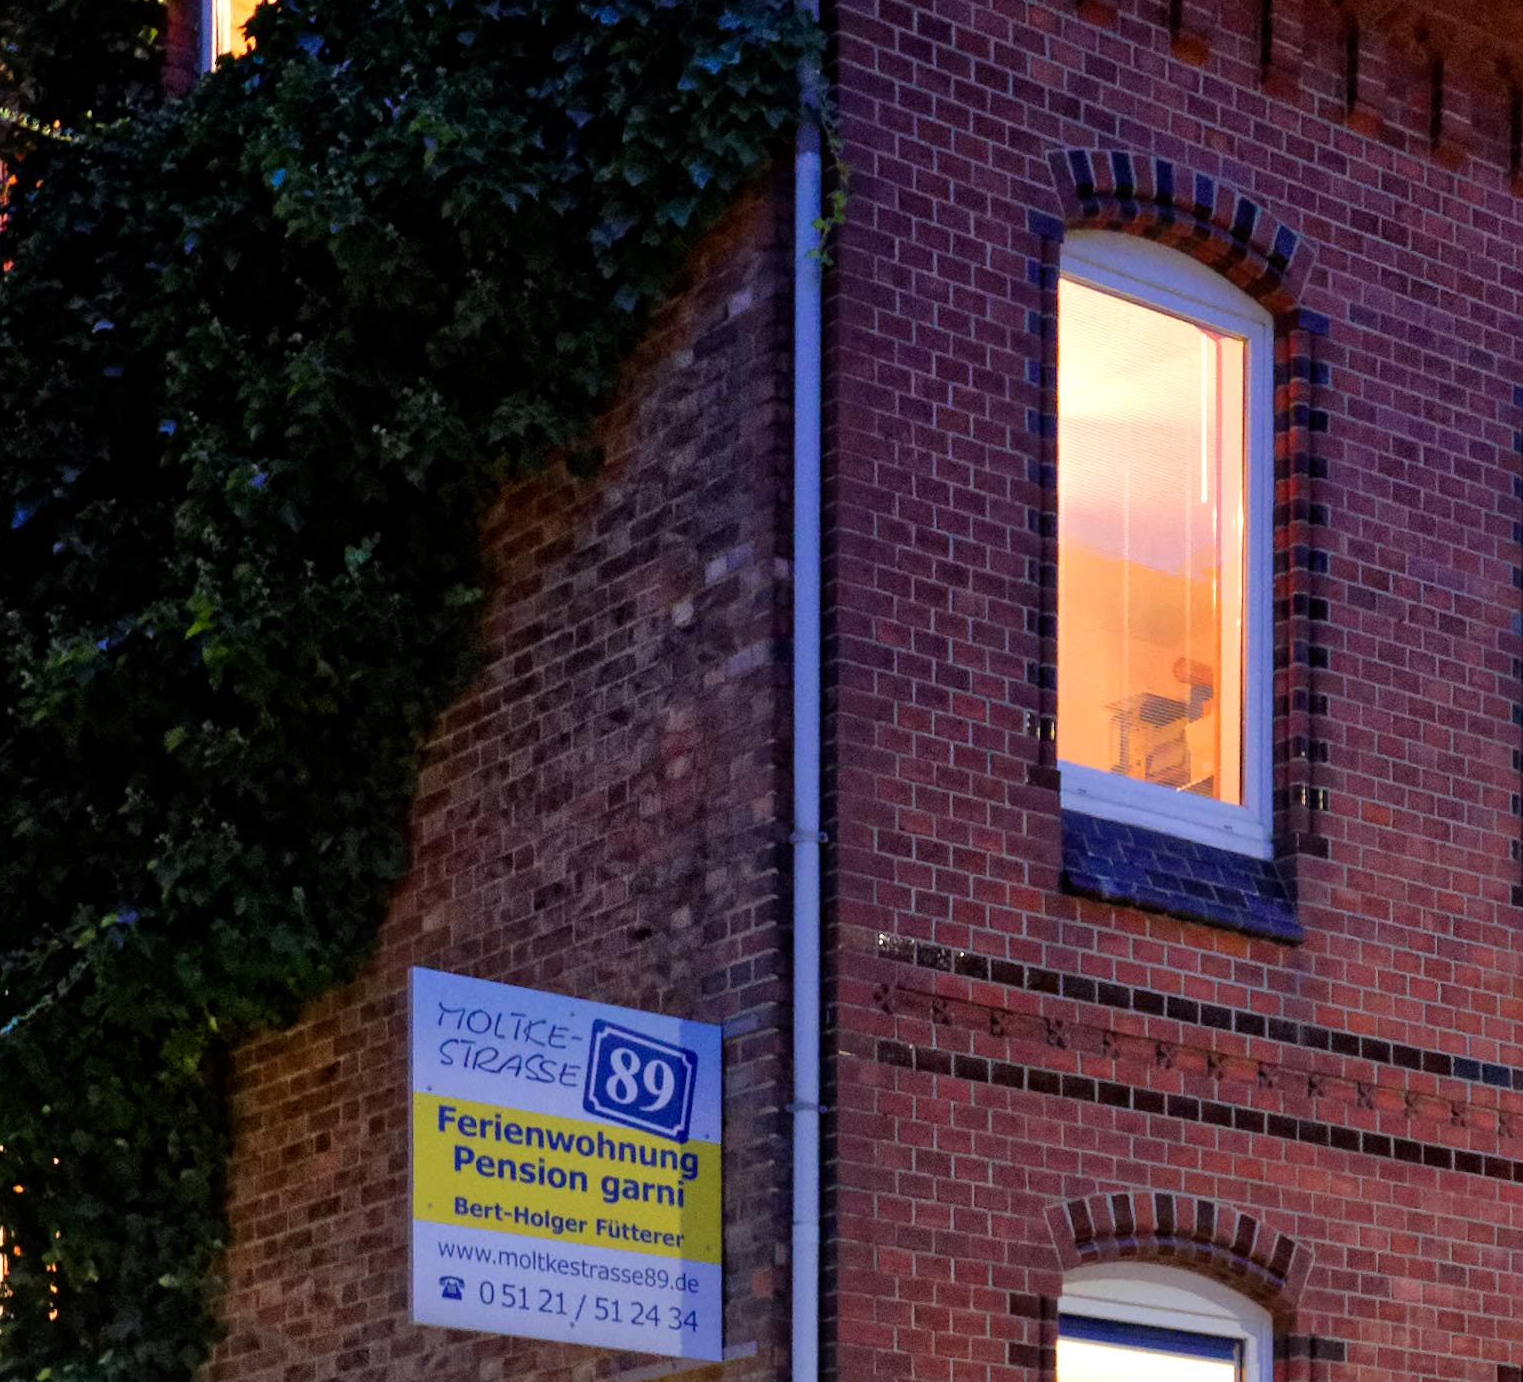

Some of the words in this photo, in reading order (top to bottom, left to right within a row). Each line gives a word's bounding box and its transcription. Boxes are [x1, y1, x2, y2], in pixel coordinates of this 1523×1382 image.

[437, 1002, 583, 1049] MOLTKE-
[439, 1038, 581, 1087] STRASSE
[605, 1046, 675, 1112] 89
[437, 1104, 699, 1181] Ferienwohnung
[453, 1144, 588, 1193] Pension
[601, 1174, 684, 1208] garni
[453, 1196, 588, 1235] Bert-Holger
[595, 1217, 685, 1248] Fütterer
[437, 1241, 700, 1294] www.moltkestrasse89.de
[501, 1283, 530, 1311] 51
[538, 1288, 567, 1316] 21
[594, 1296, 623, 1323] 51
[630, 1301, 661, 1328] 24
[667, 1306, 699, 1333] 34
